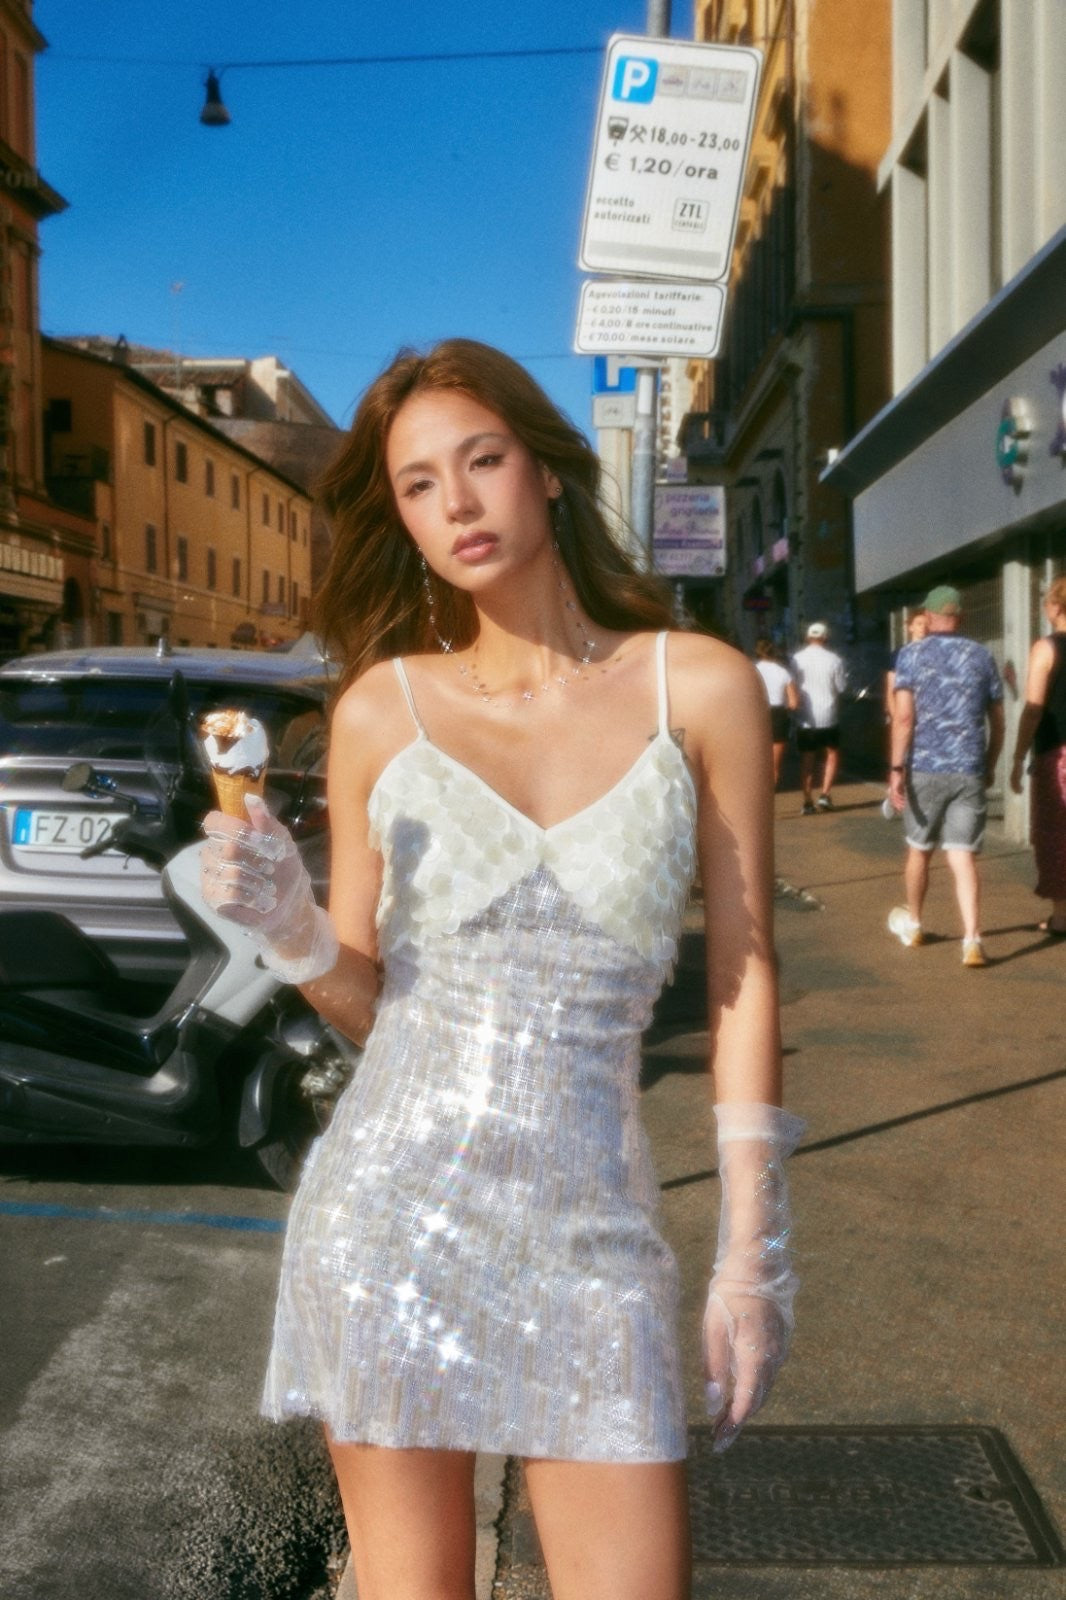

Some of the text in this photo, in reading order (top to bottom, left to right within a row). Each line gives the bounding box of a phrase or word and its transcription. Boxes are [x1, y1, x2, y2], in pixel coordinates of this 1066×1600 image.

[621, 60, 650, 99] P
[596, 195, 635, 208] eccetto
[680, 202, 702, 219] ZTL
[594, 211, 651, 224] autorizzati
[588, 289, 650, 299] Agevolazioni
[642, 307, 676, 317] minuti
[652, 320, 713, 332] continuative
[661, 335, 696, 345] solare
